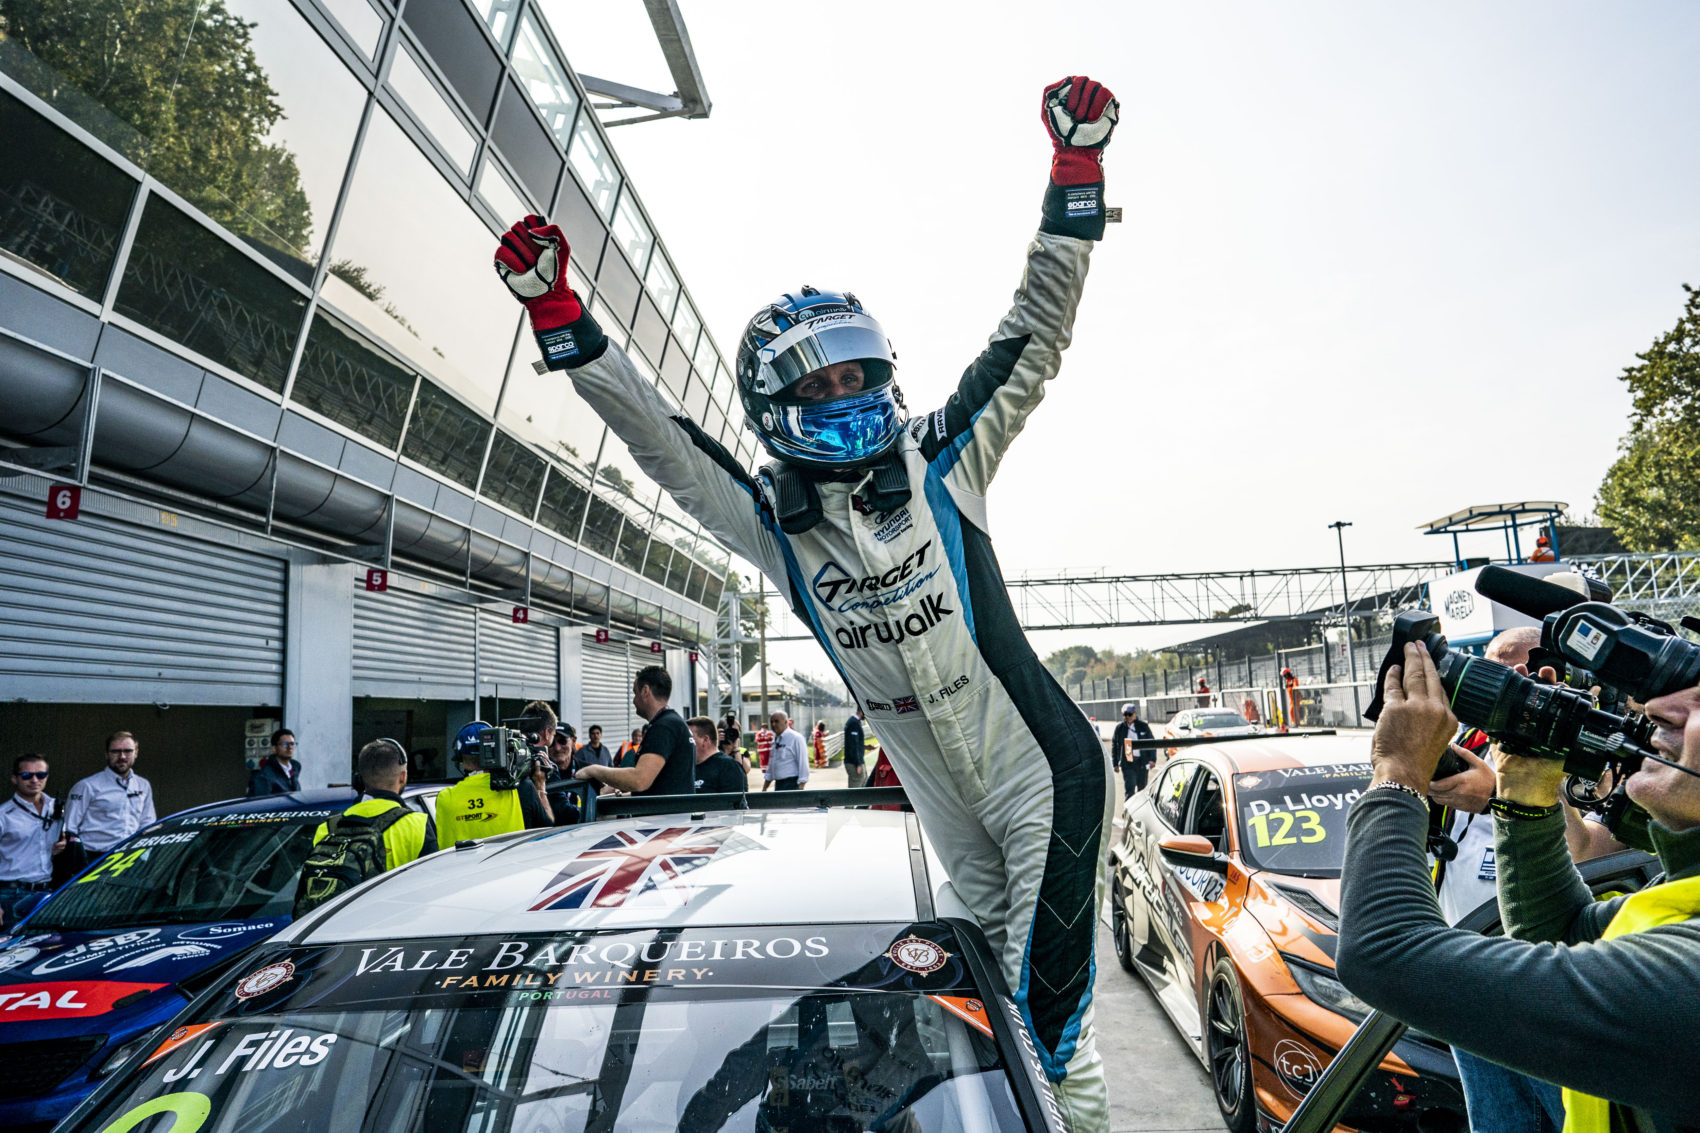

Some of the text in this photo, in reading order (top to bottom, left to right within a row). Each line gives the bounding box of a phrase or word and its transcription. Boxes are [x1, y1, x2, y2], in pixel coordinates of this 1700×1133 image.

[1067, 200, 1096, 210] sparco
[804, 315, 856, 330] TARGET
[548, 342, 575, 354] sparco
[56, 490, 71, 510] 6
[874, 507, 910, 538] HYUNDAI
[876, 513, 913, 542] MOTORSPORT
[372, 572, 382, 586] 5
[817, 539, 932, 603] TARGET
[838, 563, 942, 613] Competition
[516, 610, 525, 619] 4
[835, 592, 954, 649] airwalk
[599, 631, 606, 640] 3
[653, 643, 659, 651] 2
[928, 674, 970, 704] J. FILES
[1277, 766, 1328, 779] VALE
[467, 798, 485, 810] 33
[1249, 789, 1363, 817] D. Lloyd
[180, 815, 220, 827] VALE
[220, 810, 332, 823] BARQUEIROS
[1248, 810, 1327, 848] 123
[130, 831, 200, 850] BRICHE
[77, 848, 147, 885] 24
[209, 922, 274, 935] Somaco
[64, 937, 160, 964] COMPETITION
[65, 932, 141, 958] JSB
[355, 936, 830, 977] VALE BARQUEIROS
[440, 967, 710, 990] FAMILY WINERY
[517, 990, 612, 1001] PORTUGAL
[163, 1029, 338, 1083] J. Files
[789, 1073, 837, 1090] Sabelt
